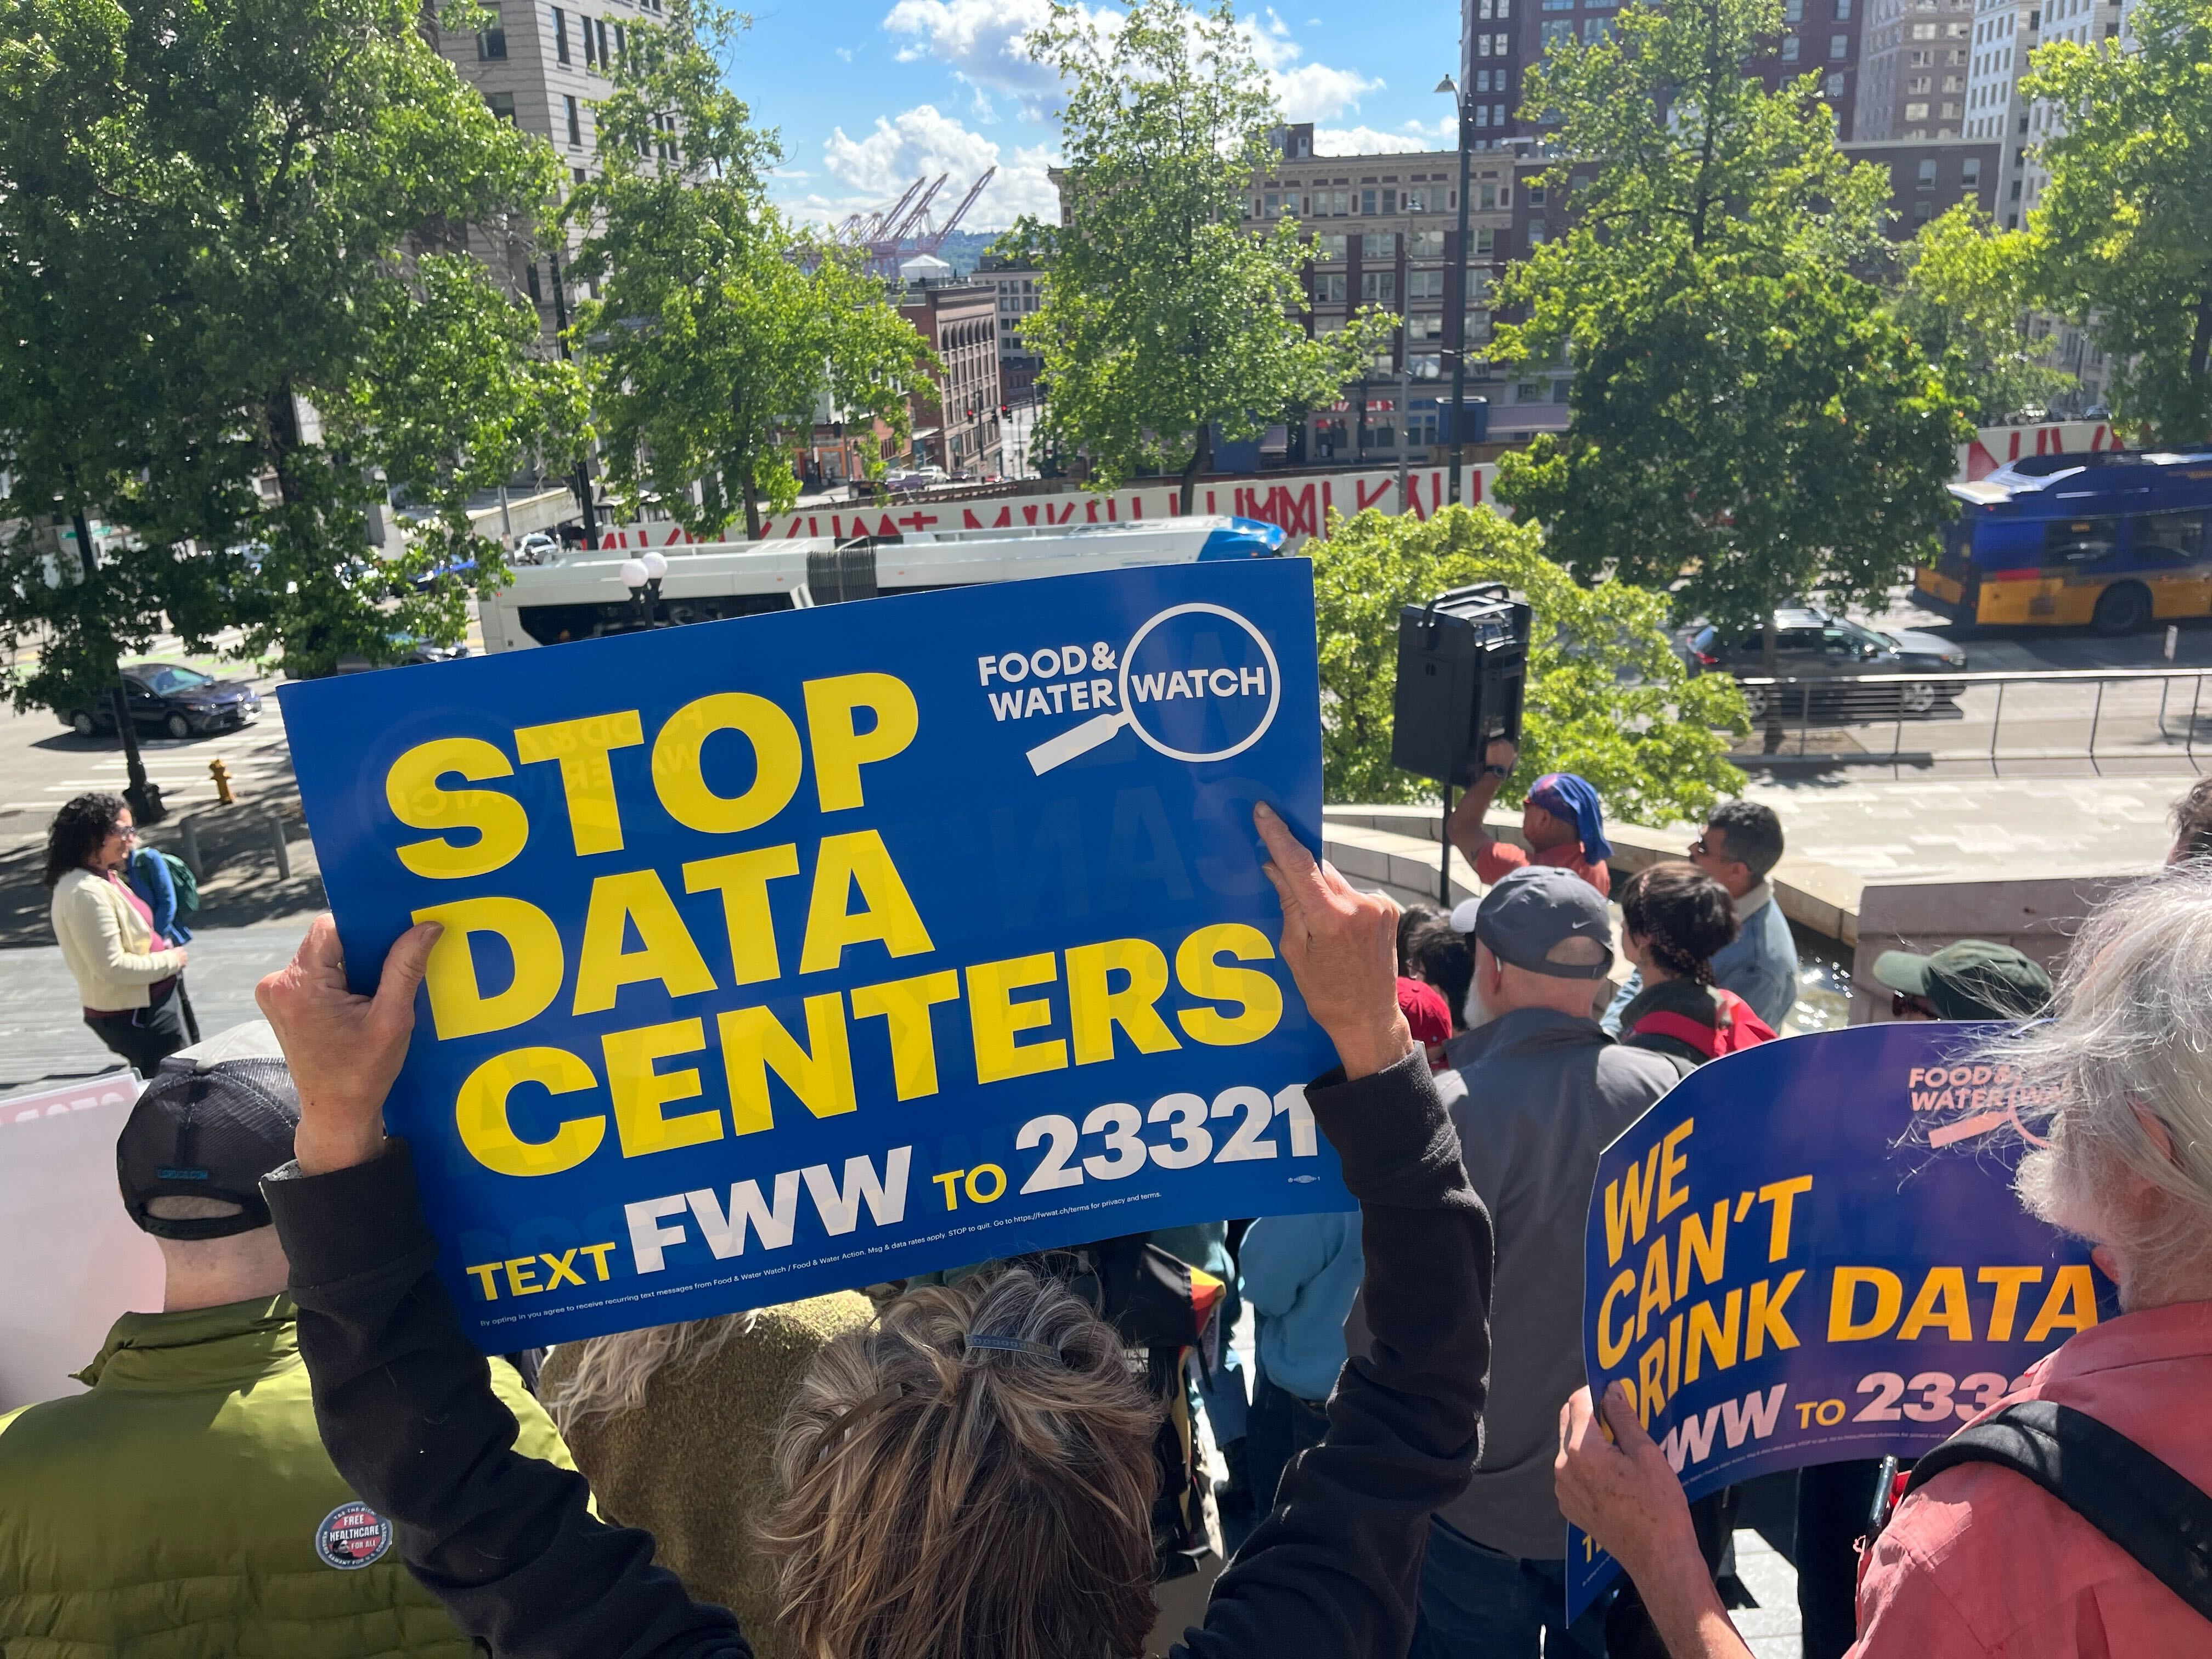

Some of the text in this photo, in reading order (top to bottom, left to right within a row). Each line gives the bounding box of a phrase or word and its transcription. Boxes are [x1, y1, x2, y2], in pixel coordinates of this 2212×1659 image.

[988, 667, 1266, 721] WATER WATCH
[386, 673, 917, 879] STOP
[411, 829, 934, 1040] DATA
[456, 923, 1282, 1176] CENTERS
[466, 1084, 1318, 1300] TEXT FWW TO 23321
[1604, 1117, 1694, 1268] WE
[491, 1315, 517, 1325] opting
[527, 1311, 543, 1320] you
[542, 1307, 566, 1317] agree
[575, 1300, 605, 1311] receive
[604, 1294, 640, 1306] recurring
[639, 1290, 656, 1300] text
[656, 1284, 694, 1296] messages
[693, 1281, 713, 1290] from
[713, 1276, 733, 1286] Food
[740, 1271, 763, 1281] Water
[763, 1266, 787, 1277] Watch
[792, 1259, 812, 1271] Food
[811, 1259, 819, 1267] &
[819, 1255, 840, 1265] Water
[867, 1246, 883, 1255] Msg
[883, 1243, 890, 1251] &
[890, 1241, 907, 1250] data
[907, 1237, 926, 1246] rates
[947, 1226, 968, 1237] STOP
[992, 1219, 1005, 1227] Go
[1004, 1217, 1014, 1226] to
[1090, 1201, 1102, 1210] for
[1101, 1197, 1126, 1209] privacy
[1126, 1193, 1140, 1203] and
[1597, 1174, 1813, 1370] CAN'T
[1826, 1265, 2098, 1342] DATA
[1659, 1383, 1788, 1475] WW
[1795, 1398, 1846, 1429] TO
[1852, 1371, 2033, 1423] 233
[330, 1525, 379, 1542] HEALTHCARE
[343, 1514, 364, 1526] FREE
[351, 1538, 376, 1550] FOR ALL
